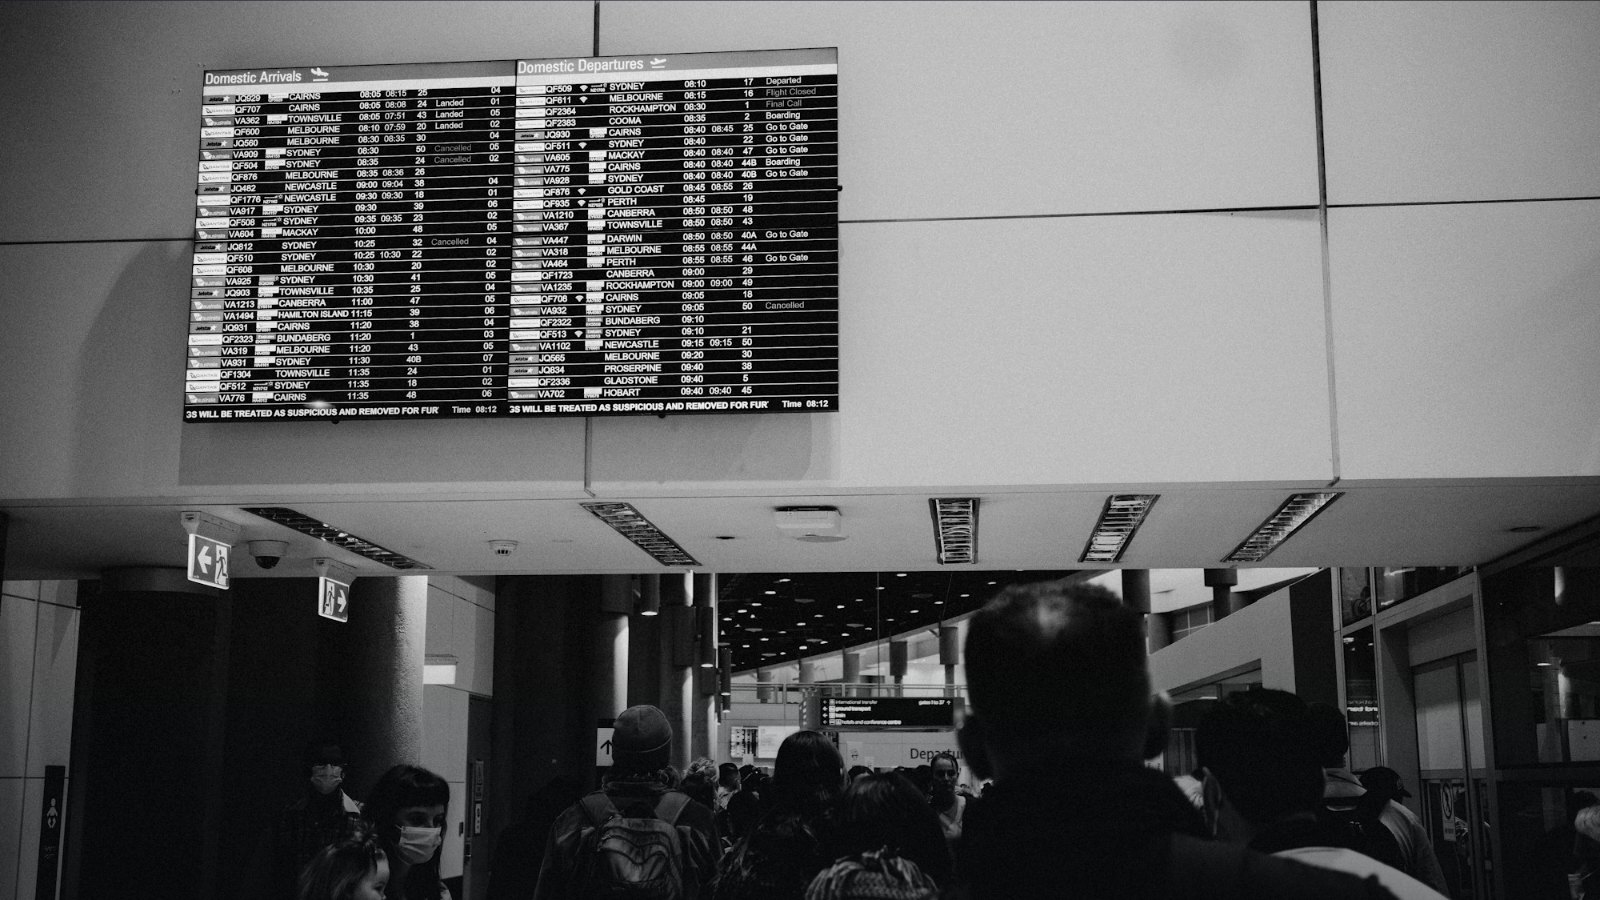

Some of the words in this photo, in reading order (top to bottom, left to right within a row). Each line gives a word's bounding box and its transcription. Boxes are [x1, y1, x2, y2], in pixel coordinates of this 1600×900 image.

[518, 59, 574, 74] Domestic
[578, 58, 644, 74] Departures
[206, 71, 256, 84] Domestic
[259, 70, 302, 83] Arrivals
[610, 81, 645, 91] SYDNEY
[684, 79, 706, 88] 08:10
[766, 75, 801, 85] Departed
[289, 92, 320, 101] CAIRNS
[609, 93, 663, 102] MELBOURNE
[766, 87, 787, 97] Flight
[789, 86, 816, 95] Closed
[289, 103, 320, 112] CAIRNS
[436, 99, 464, 107] Landed
[609, 104, 676, 114] ROCKHAMPTON
[787, 99, 802, 107] Call
[287, 114, 341, 123] TOWNSVILLE
[435, 110, 463, 118] Landed
[609, 117, 642, 125] COOMA
[766, 111, 800, 120] Boarding
[288, 125, 340, 134] MELBOURNE
[435, 122, 463, 130] Landed
[609, 128, 641, 136] CAIRNS
[766, 123, 778, 131] Go
[779, 123, 787, 131] to
[789, 122, 808, 130] Gate
[287, 137, 339, 146] MELBOURNE
[609, 139, 644, 148] SYDNEY
[285, 149, 321, 157] SYDNEY
[434, 144, 471, 152] Cancelled
[608, 151, 645, 159] MACKAY
[285, 160, 321, 168] SYDNEY
[434, 154, 471, 164] Cancelled
[608, 162, 641, 171] CAIRNS
[766, 158, 800, 166] Boarding
[285, 170, 338, 179] MELBOURNE
[608, 174, 643, 183] SYDNEY
[285, 182, 337, 191] NEWCASTLE
[356, 181, 378, 189] 09:00
[608, 186, 632, 194] GOLD
[634, 185, 664, 193] COAST
[284, 193, 336, 202] NEWCASTLE
[608, 198, 637, 206] PERTH
[282, 205, 319, 214] SYDNEY
[607, 209, 655, 218] CANBERRA
[283, 217, 318, 225] SYDNEY
[607, 220, 662, 229] TOWNSVILLE
[281, 228, 318, 236] MACKAY
[355, 226, 376, 235] 10:00
[607, 234, 642, 243] DARWIN
[766, 230, 778, 238] Go
[789, 230, 808, 238] Gate
[282, 241, 317, 250] SYDNEY
[431, 238, 469, 246] Cancelled
[607, 245, 661, 255] MELBOURNE
[281, 253, 316, 261] SYDNEY
[607, 258, 636, 266] PERTH
[281, 264, 334, 272] MELBOURNE
[606, 269, 655, 278] CANBERRA
[280, 276, 315, 284] SYDNEY
[606, 281, 674, 290] ROCKHAMPTON
[278, 287, 334, 296] TOWNSVILLE
[352, 286, 373, 294] 10:35
[606, 293, 639, 302] CAIRNS
[682, 291, 704, 300] 09:05
[278, 299, 326, 310] CANBERRA
[605, 305, 642, 313] SYDNEY
[765, 301, 804, 309] Cancelled
[277, 311, 319, 319] HAMILTON
[320, 310, 349, 318] ISLAND
[605, 316, 660, 325] BUNDABERG
[276, 322, 310, 331] CAIRNS
[605, 329, 641, 337] SYDNEY
[277, 334, 331, 342] BUNDABERG
[605, 340, 659, 349] NEWCASTLE
[275, 345, 330, 354] MELBOURNE
[605, 352, 660, 361] MELBOURNE
[681, 351, 704, 359] 09:20
[275, 357, 311, 366] SYDNEY
[349, 356, 370, 364] 11:30
[604, 364, 661, 373] PROSERPINE
[275, 369, 330, 378] TOWNSVILLE
[274, 381, 310, 389] SYDNEY
[604, 376, 658, 385] GLADSTONE
[604, 388, 641, 397] HOBART
[273, 393, 306, 402] CAIRNS
[522, 405, 543, 413] WILL
[558, 404, 597, 412] TREATED
[612, 403, 664, 411] SUSPICIOUS
[665, 402, 684, 410] AND
[686, 402, 728, 410] REMOVED
[730, 401, 748, 409] FOR
[782, 400, 802, 408] Time
[199, 410, 219, 418] WILL
[221, 410, 232, 418] BE
[274, 409, 286, 417] AS
[287, 408, 338, 417] SUSPICIOUS
[358, 407, 400, 415] REMOVED
